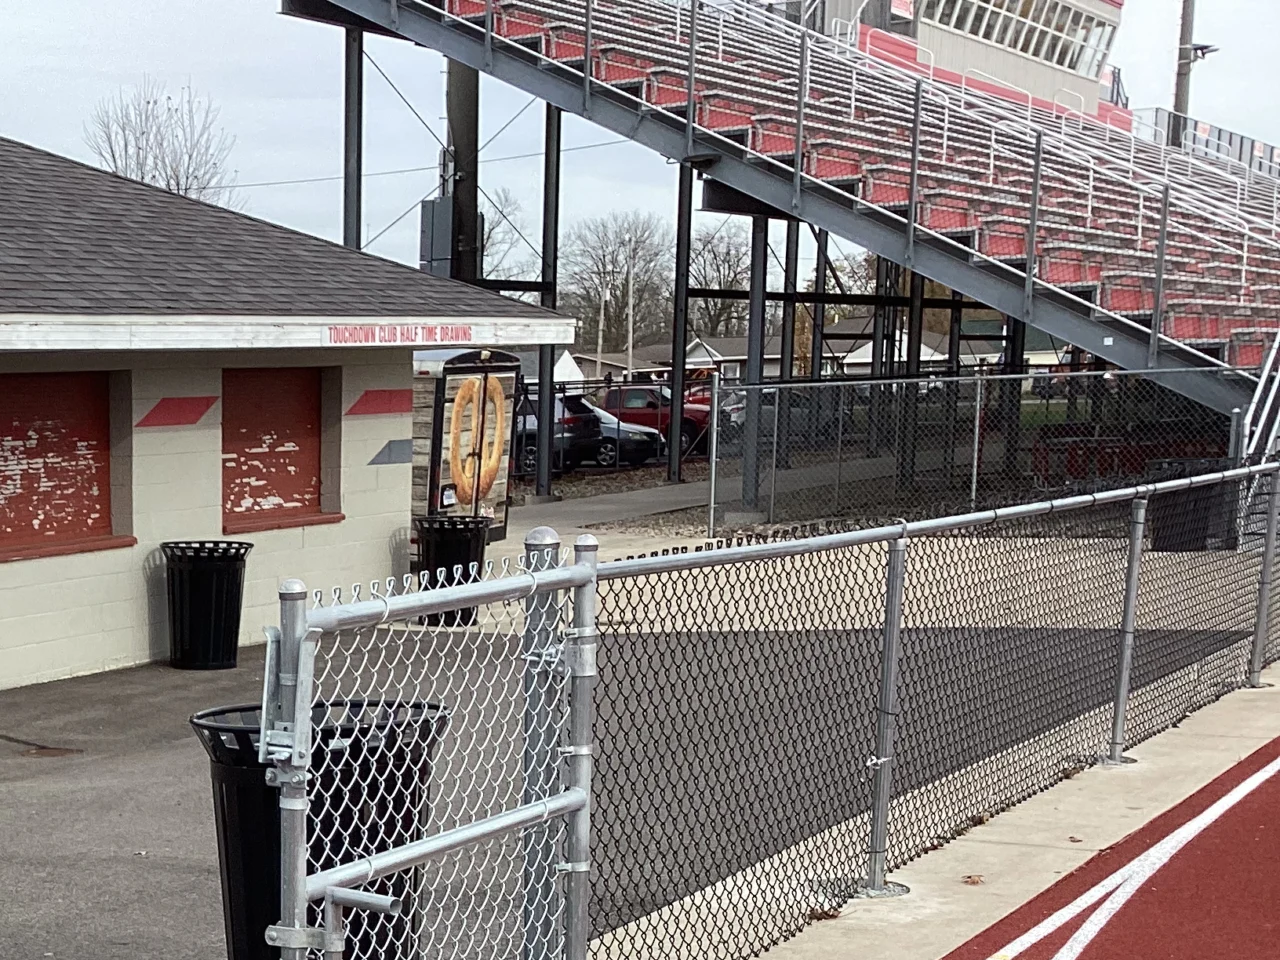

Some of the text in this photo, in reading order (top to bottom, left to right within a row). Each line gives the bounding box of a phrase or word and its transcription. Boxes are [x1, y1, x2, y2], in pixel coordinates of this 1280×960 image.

[328, 325, 472, 344] TOUCHDOWN CLUB HALF TIME DRAWING
